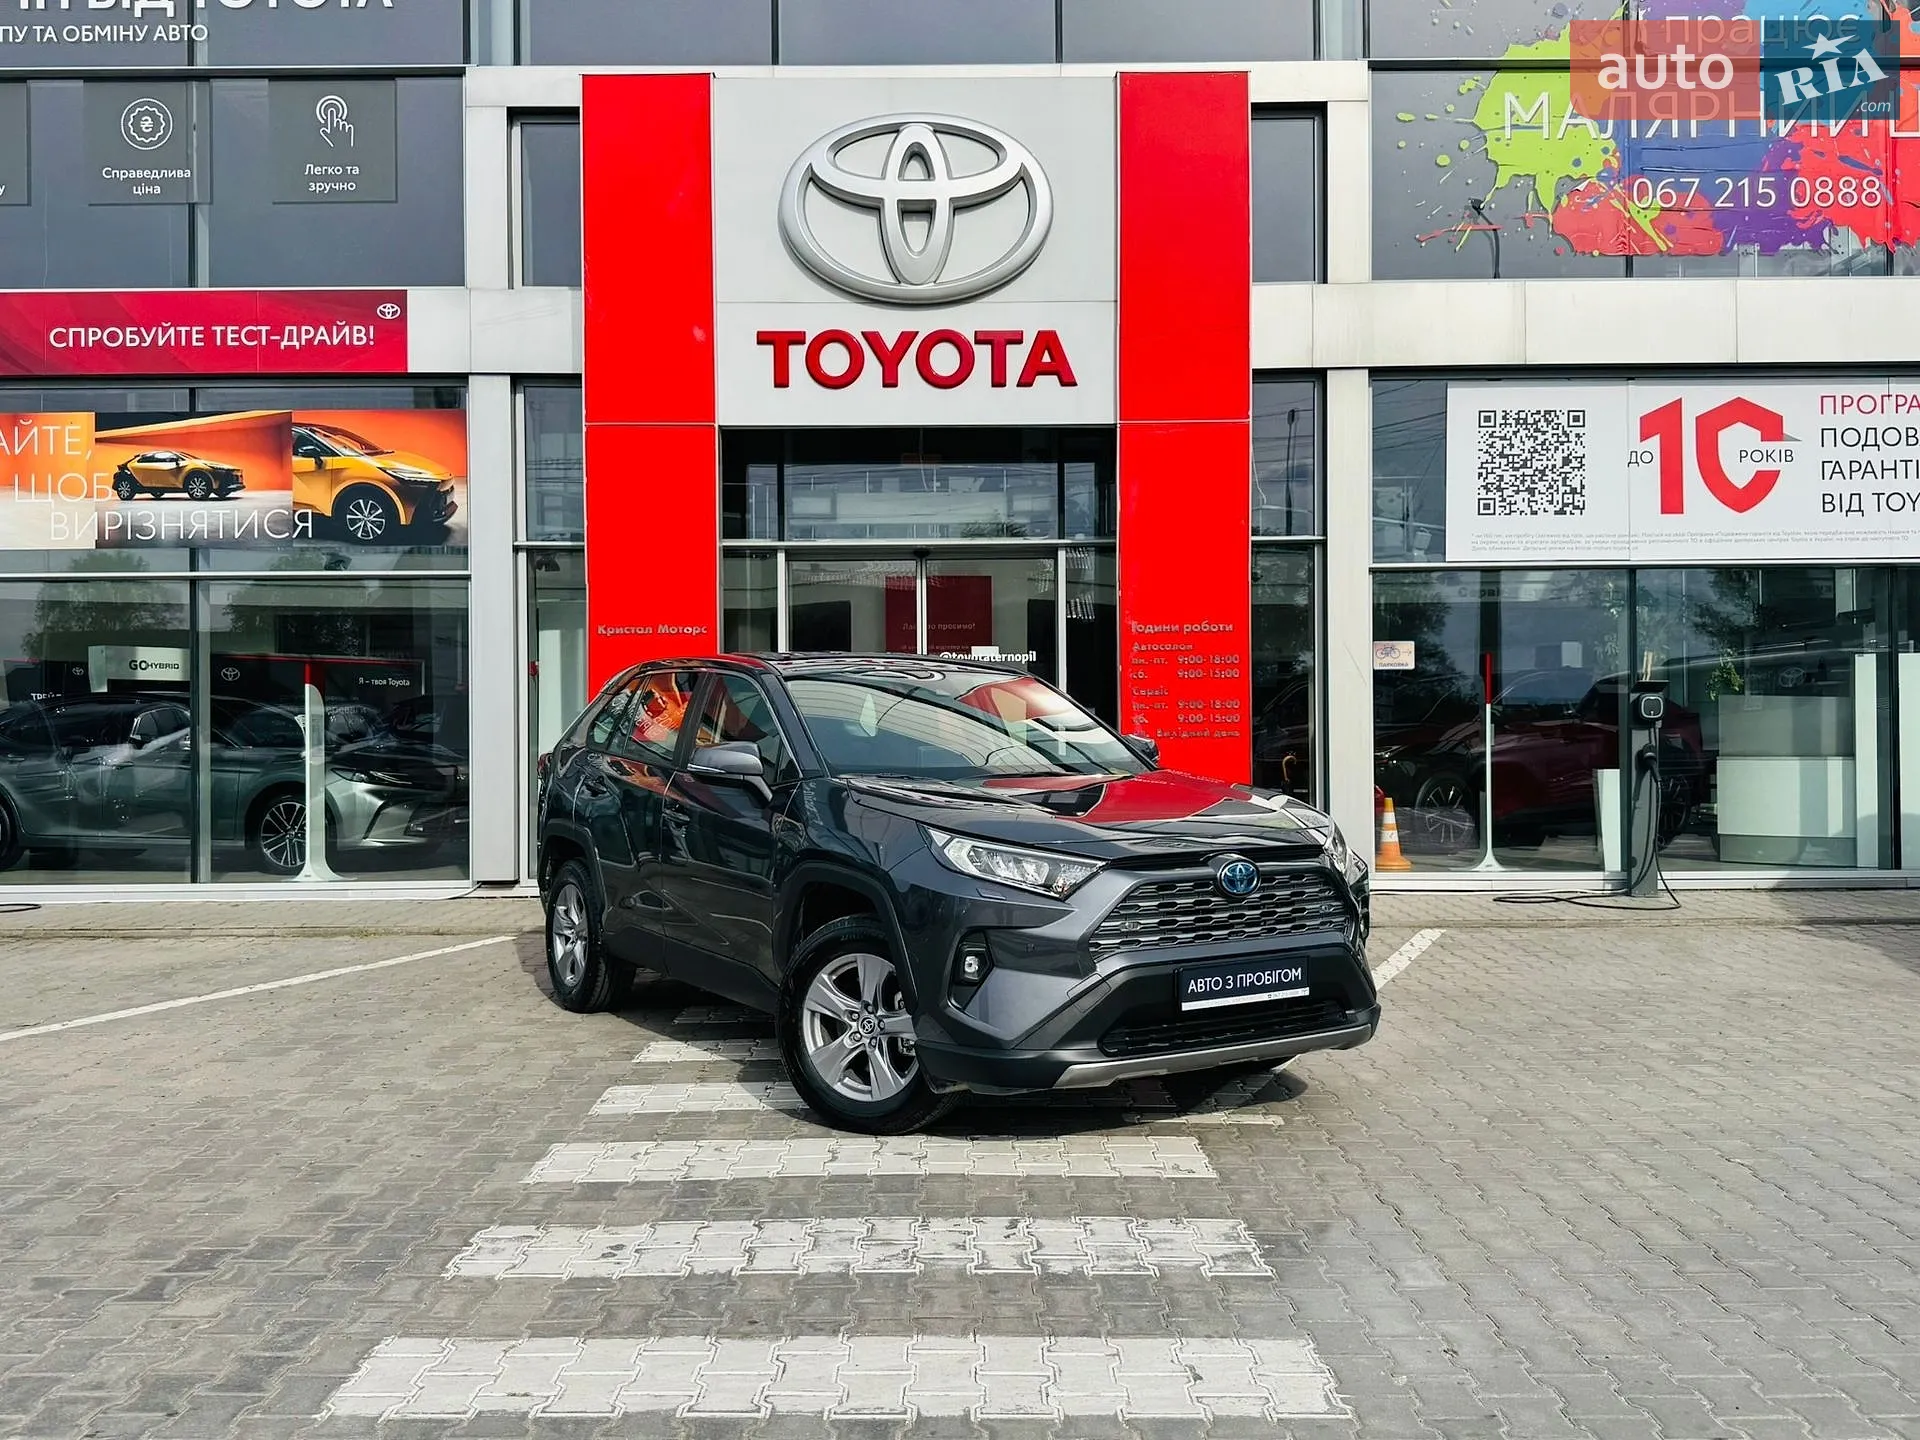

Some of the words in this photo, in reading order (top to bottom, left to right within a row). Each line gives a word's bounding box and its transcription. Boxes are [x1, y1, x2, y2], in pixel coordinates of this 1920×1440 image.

[33, 25, 58, 42] ТА
[62, 25, 149, 42] ОБМІНУ
[153, 24, 208, 41] АВТО
[102, 167, 191, 180] Справедлива
[304, 164, 340, 176] Легко
[345, 166, 359, 175] та
[133, 181, 161, 195] ціна
[308, 181, 356, 193] зручно
[1632, 178, 1700, 208] 067
[1714, 177, 1776, 208] 215
[1790, 176, 1881, 207] 0888
[49, 322, 204, 348] СПРОБУЙТЕ
[211, 320, 375, 350] ТЕСТ-ДРАЙВ!
[757, 329, 1078, 389] TOYOTA
[1627, 450, 1654, 467] ДО
[1739, 449, 1794, 463] РОКІВ
[14, 472, 113, 509] ЩОБ
[1822, 493, 1864, 517] ВІД
[50, 509, 313, 541] ВИРІЗНЯТИСЯ
[598, 625, 653, 637] Кристал
[657, 624, 708, 636] Моторс
[1183, 621, 1234, 634] роботи
[1132, 642, 1193, 652] Автосалон
[388, 678, 410, 688] Toyota
[1188, 977, 1222, 994] АВТО
[1237, 967, 1302, 987] ПРОБІГОМ
